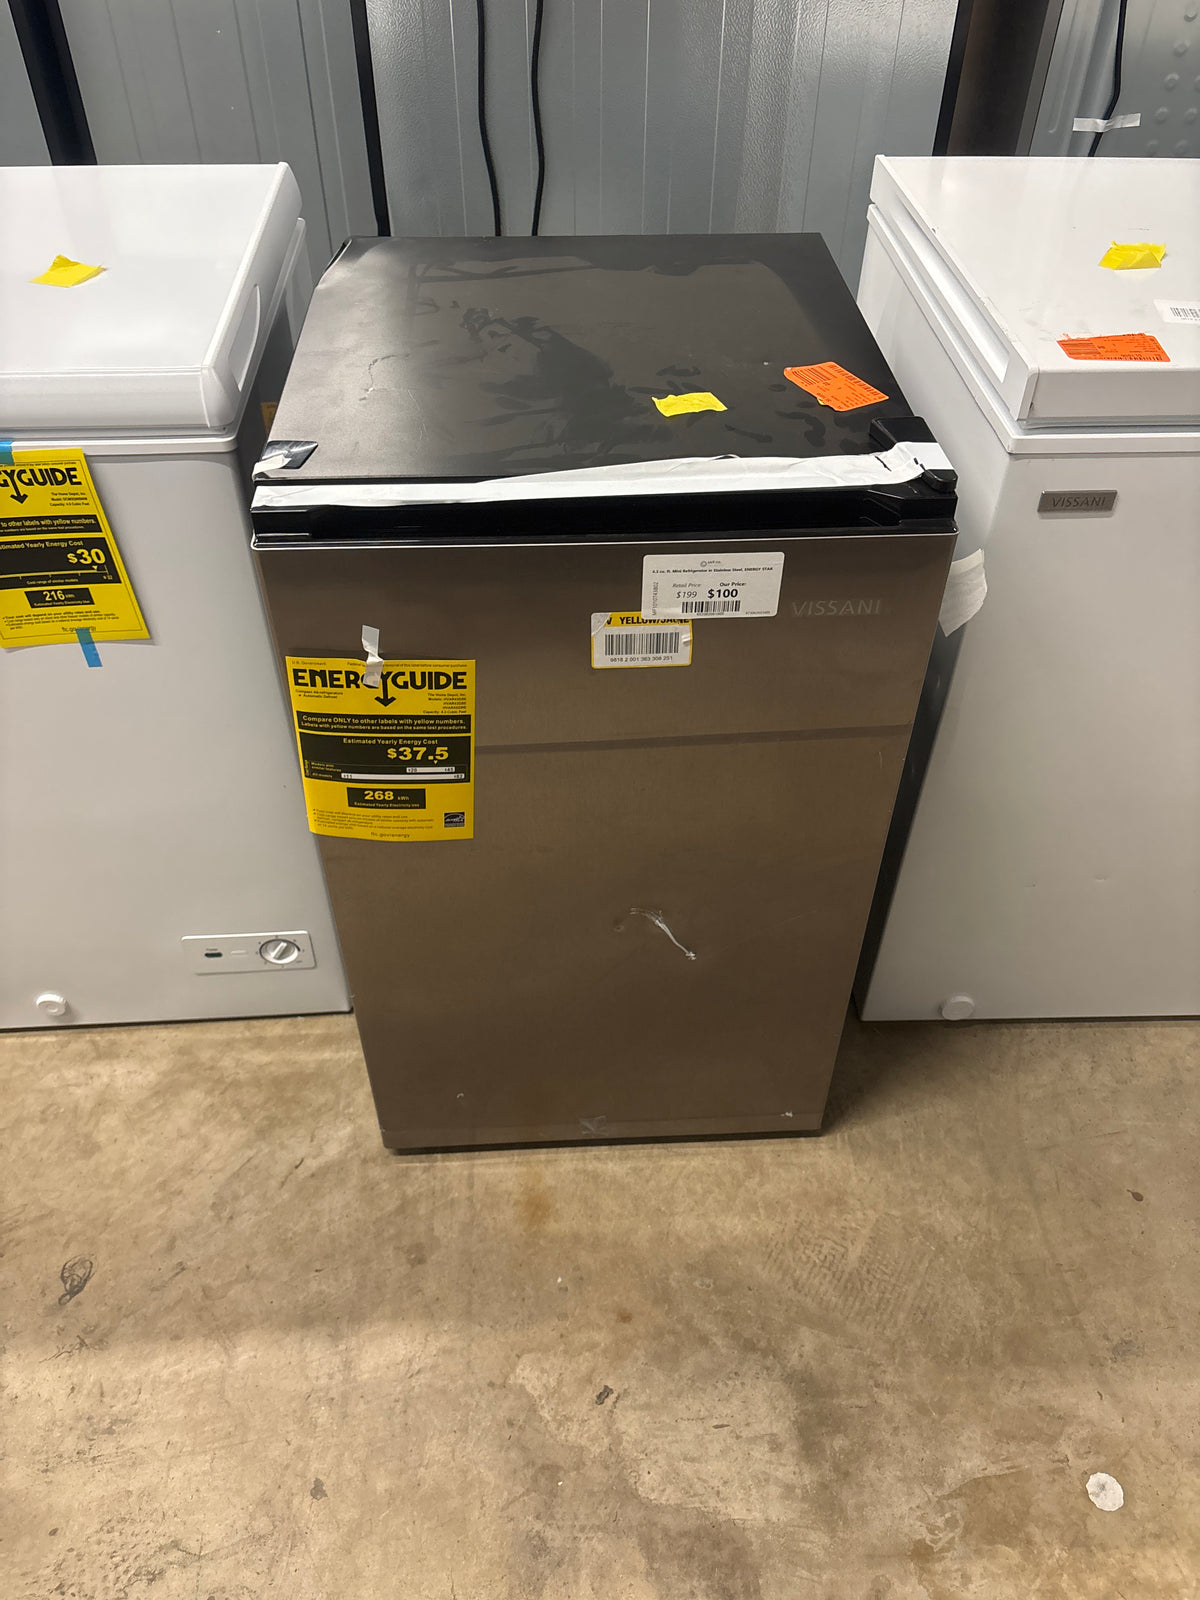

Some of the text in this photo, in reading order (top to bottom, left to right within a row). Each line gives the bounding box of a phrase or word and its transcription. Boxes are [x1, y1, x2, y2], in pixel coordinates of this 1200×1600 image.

[1052, 496, 1106, 507] VISSANI
[67, 548, 106, 565] $30
[43, 590, 65, 601] 216
[676, 591, 698, 599] $199
[707, 588, 738, 599] $100
[792, 599, 880, 616] VISSANI
[292, 668, 467, 690] ENERYGUIDE
[302, 715, 332, 723] Compare
[343, 737, 376, 745] Estimated
[377, 738, 398, 746] Yearly
[399, 738, 422, 746] Energy
[387, 746, 449, 760] $37.5
[364, 790, 394, 801] 268
